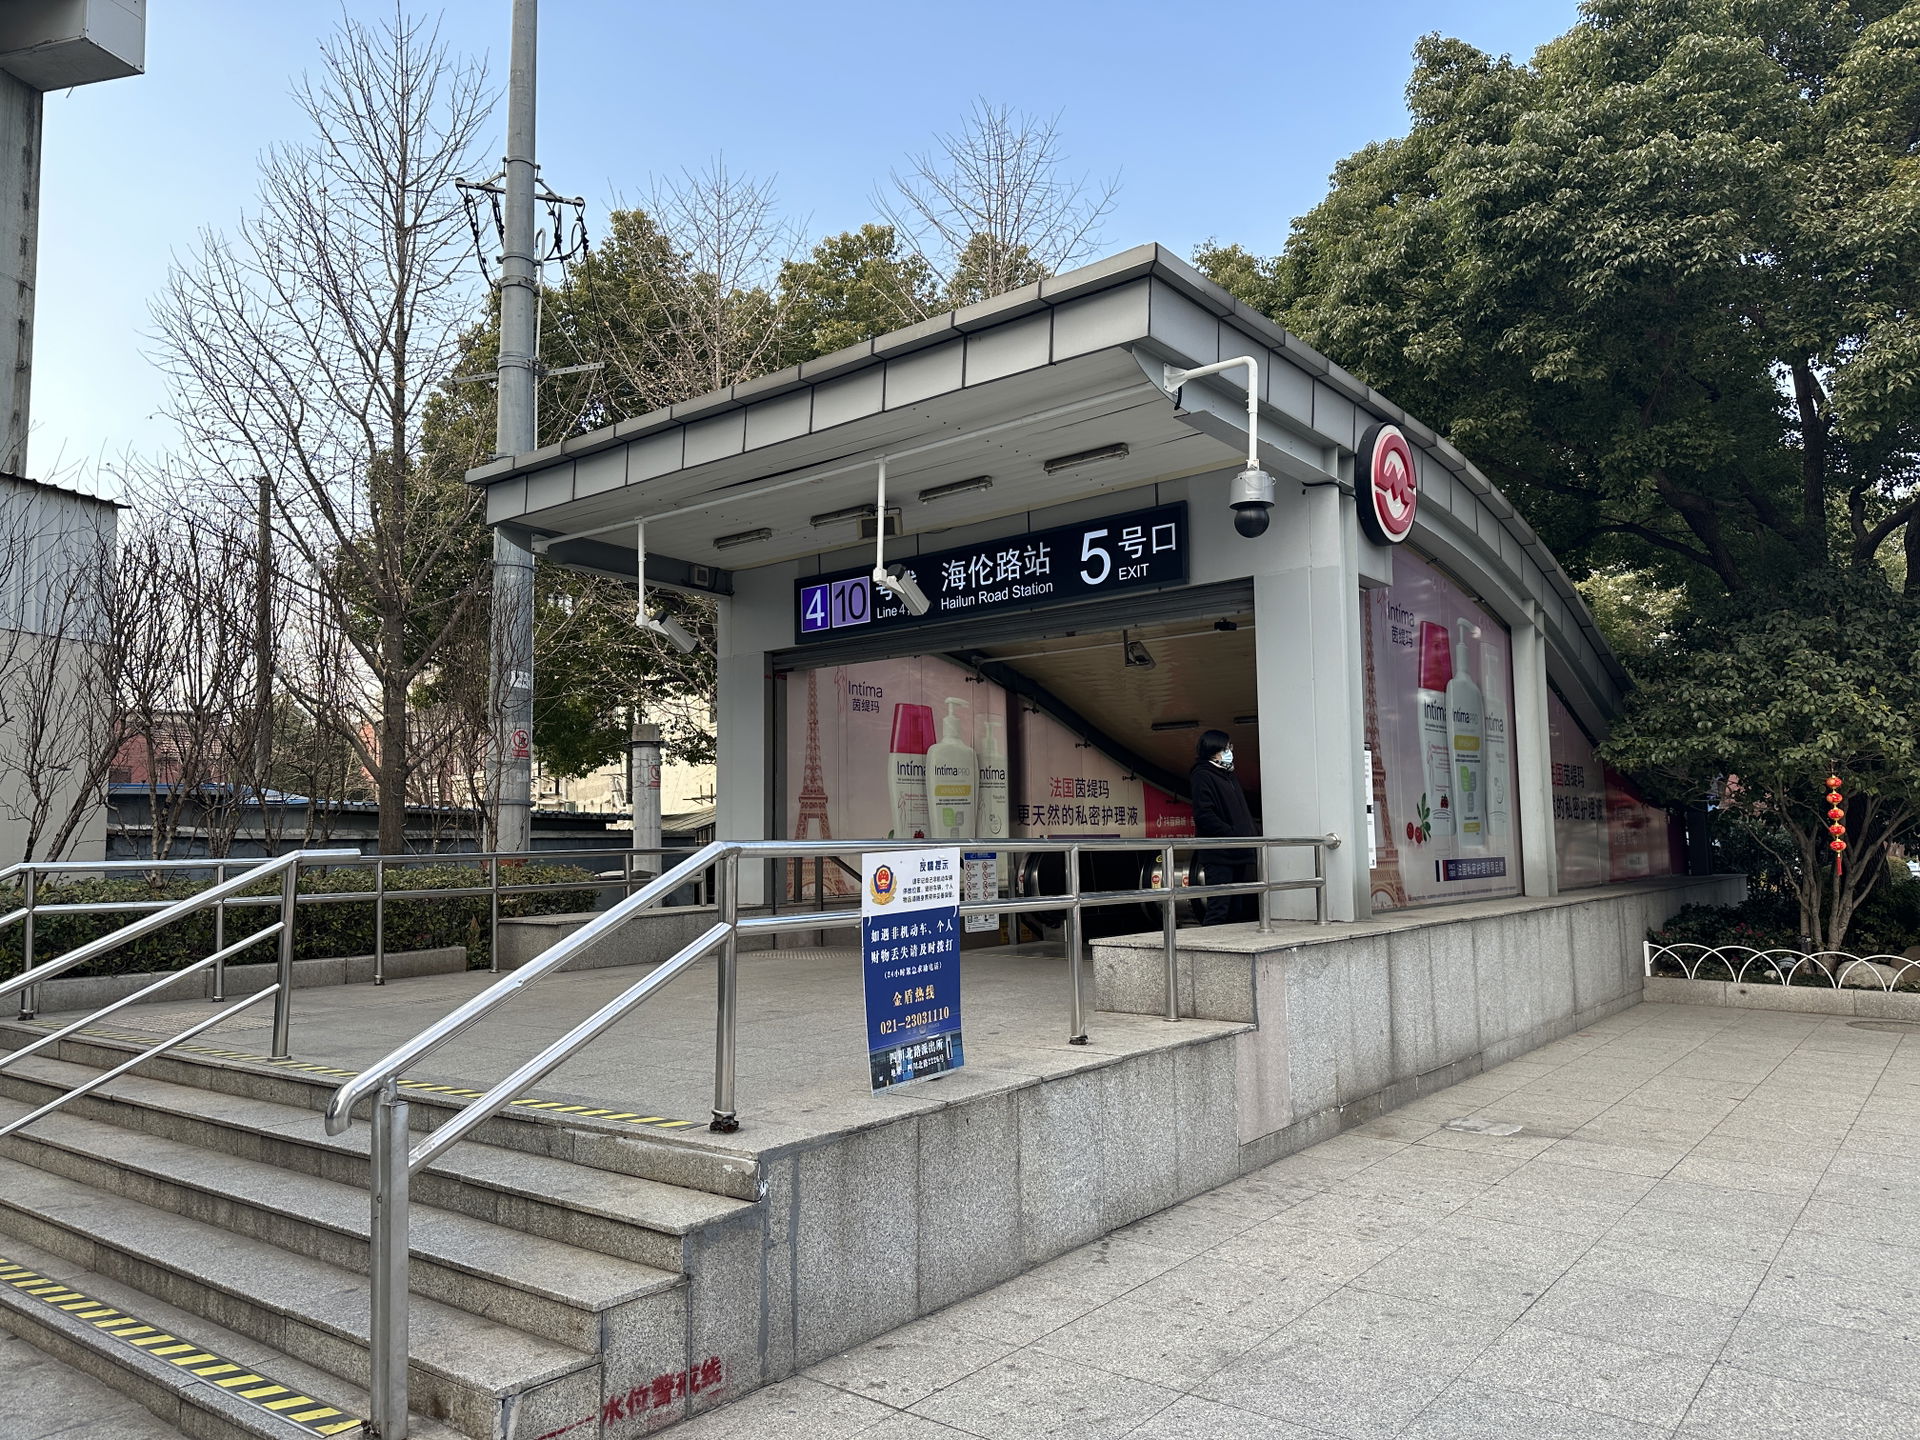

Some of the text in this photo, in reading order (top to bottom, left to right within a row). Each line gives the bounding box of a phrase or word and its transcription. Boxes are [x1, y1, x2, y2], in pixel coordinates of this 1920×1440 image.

[1080, 522, 1176, 585] 5 号口
[941, 541, 1051, 592] 海伦路站
[1118, 563, 1149, 581] EXIT
[805, 589, 825, 627] 4
[834, 582, 867, 622] 10
[941, 580, 1054, 611] Hailun Road Station
[877, 607, 898, 619] Line
[852, 698, 880, 714] 茵缇玛
[1049, 776, 1110, 799] 法国茵缇玛
[1017, 804, 1139, 827] 更天然的私密护理液
[871, 918, 953, 943] 如遇非机动车、个人
[871, 939, 953, 964] 财物丢失请及时拨打
[892, 984, 935, 1007] 金盾热线
